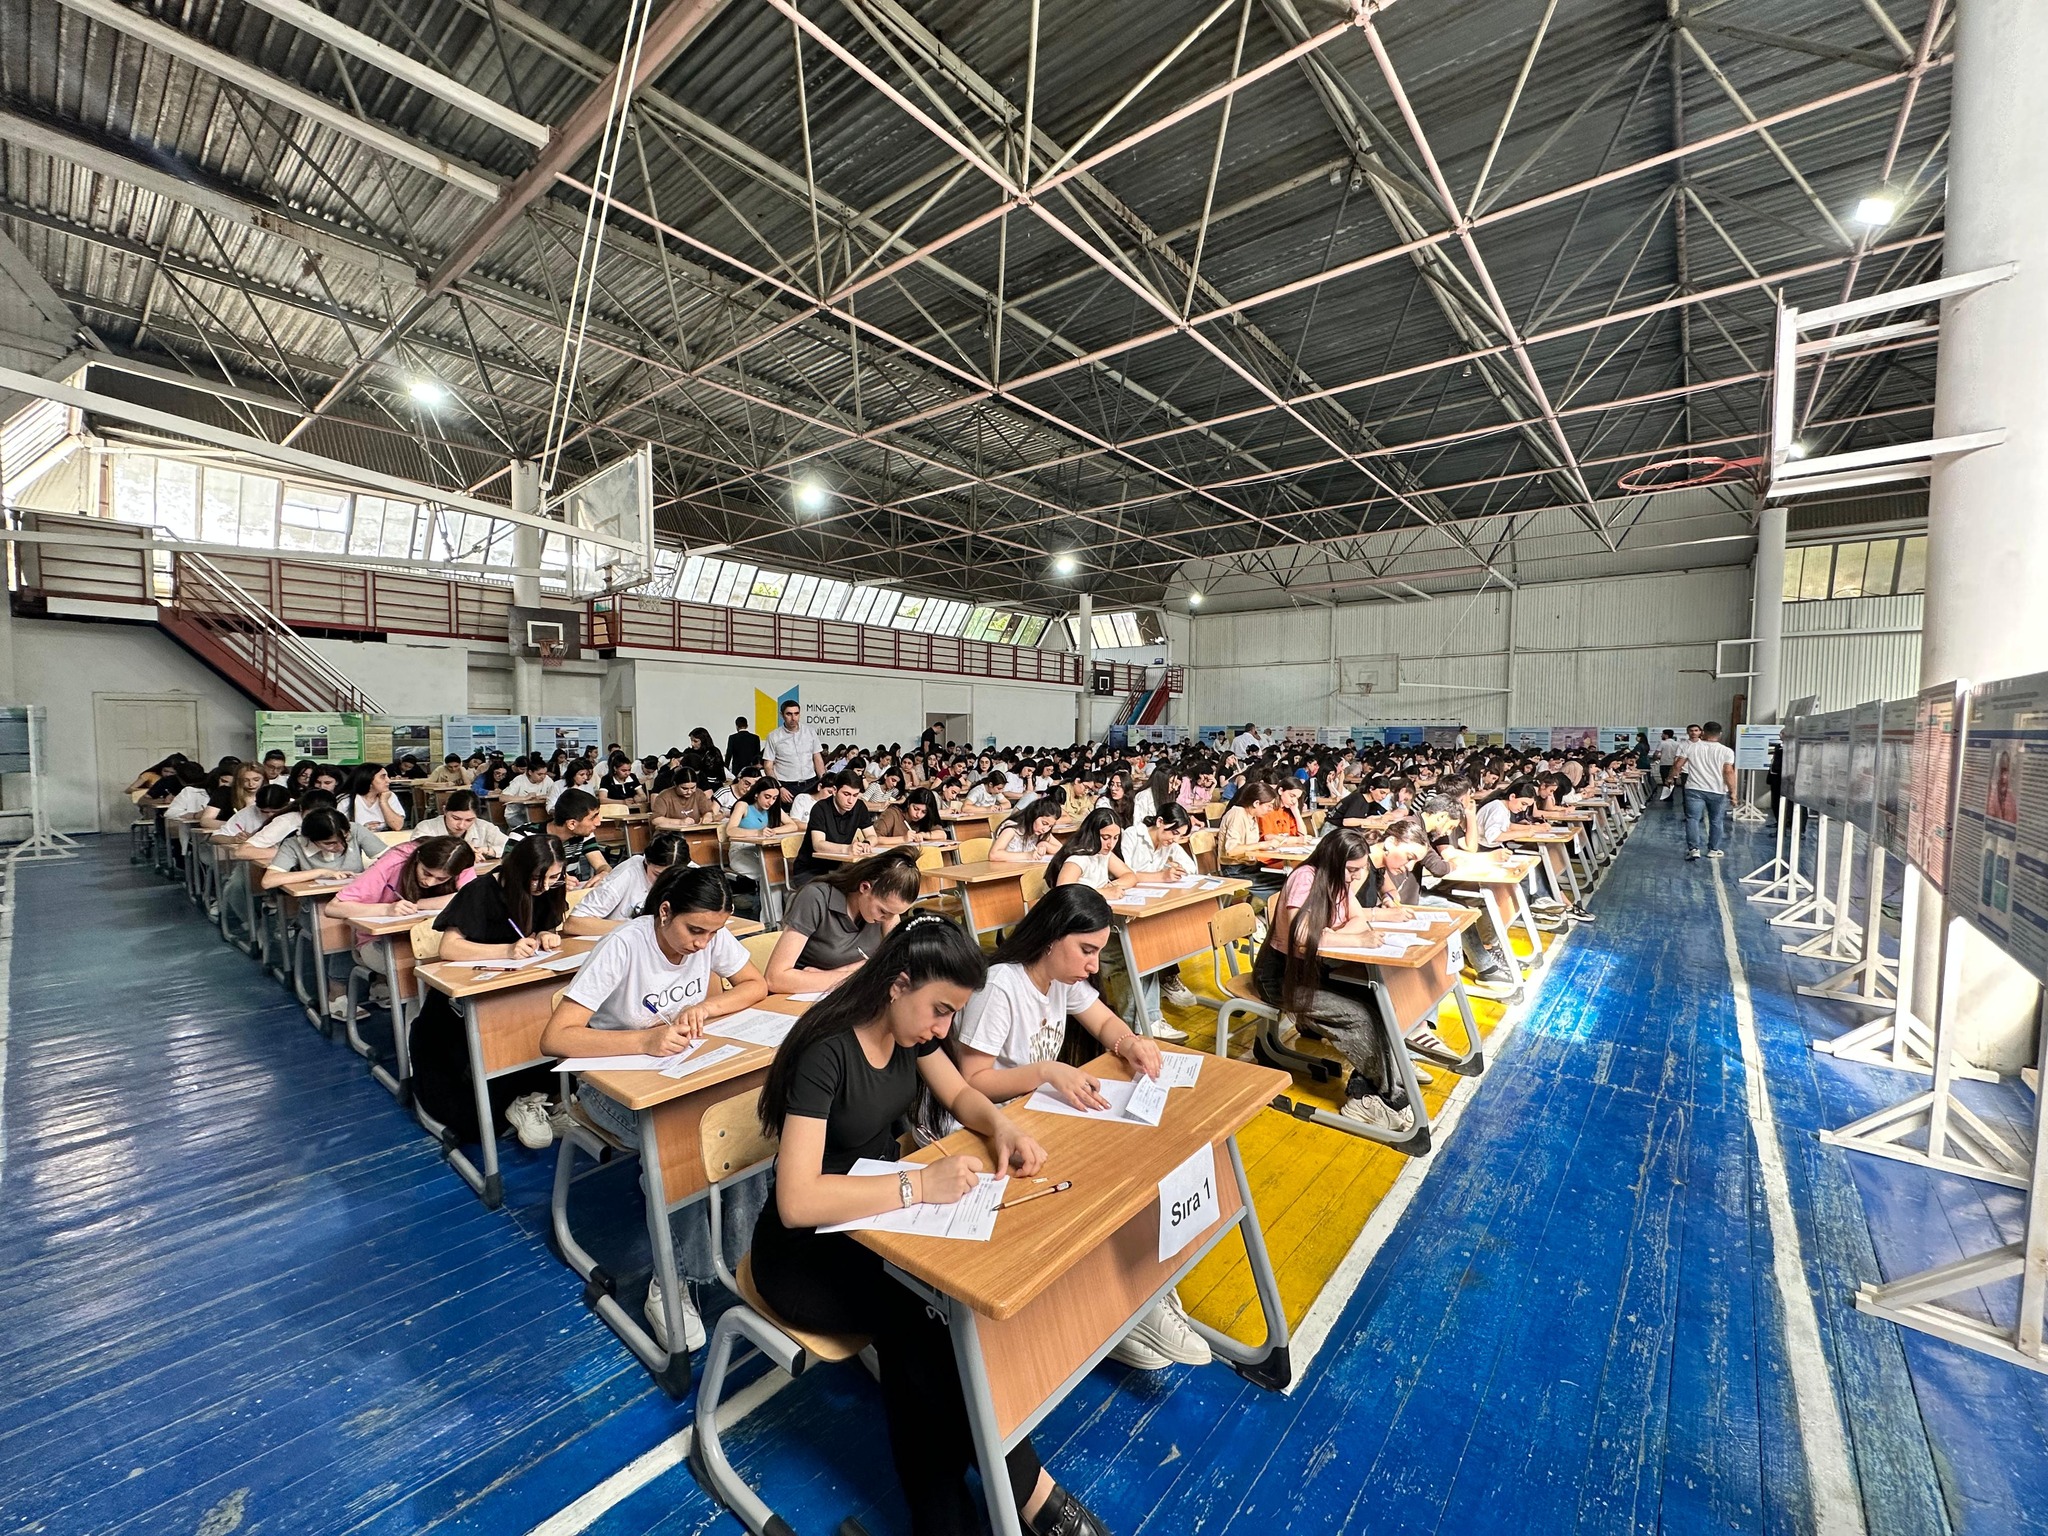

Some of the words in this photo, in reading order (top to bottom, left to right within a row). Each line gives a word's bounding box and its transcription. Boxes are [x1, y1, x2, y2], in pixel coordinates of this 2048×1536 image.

[642, 977, 702, 1010] GUCCI
[1171, 1192, 1201, 1227] Sıra
[1203, 1177, 1211, 1200] 1
